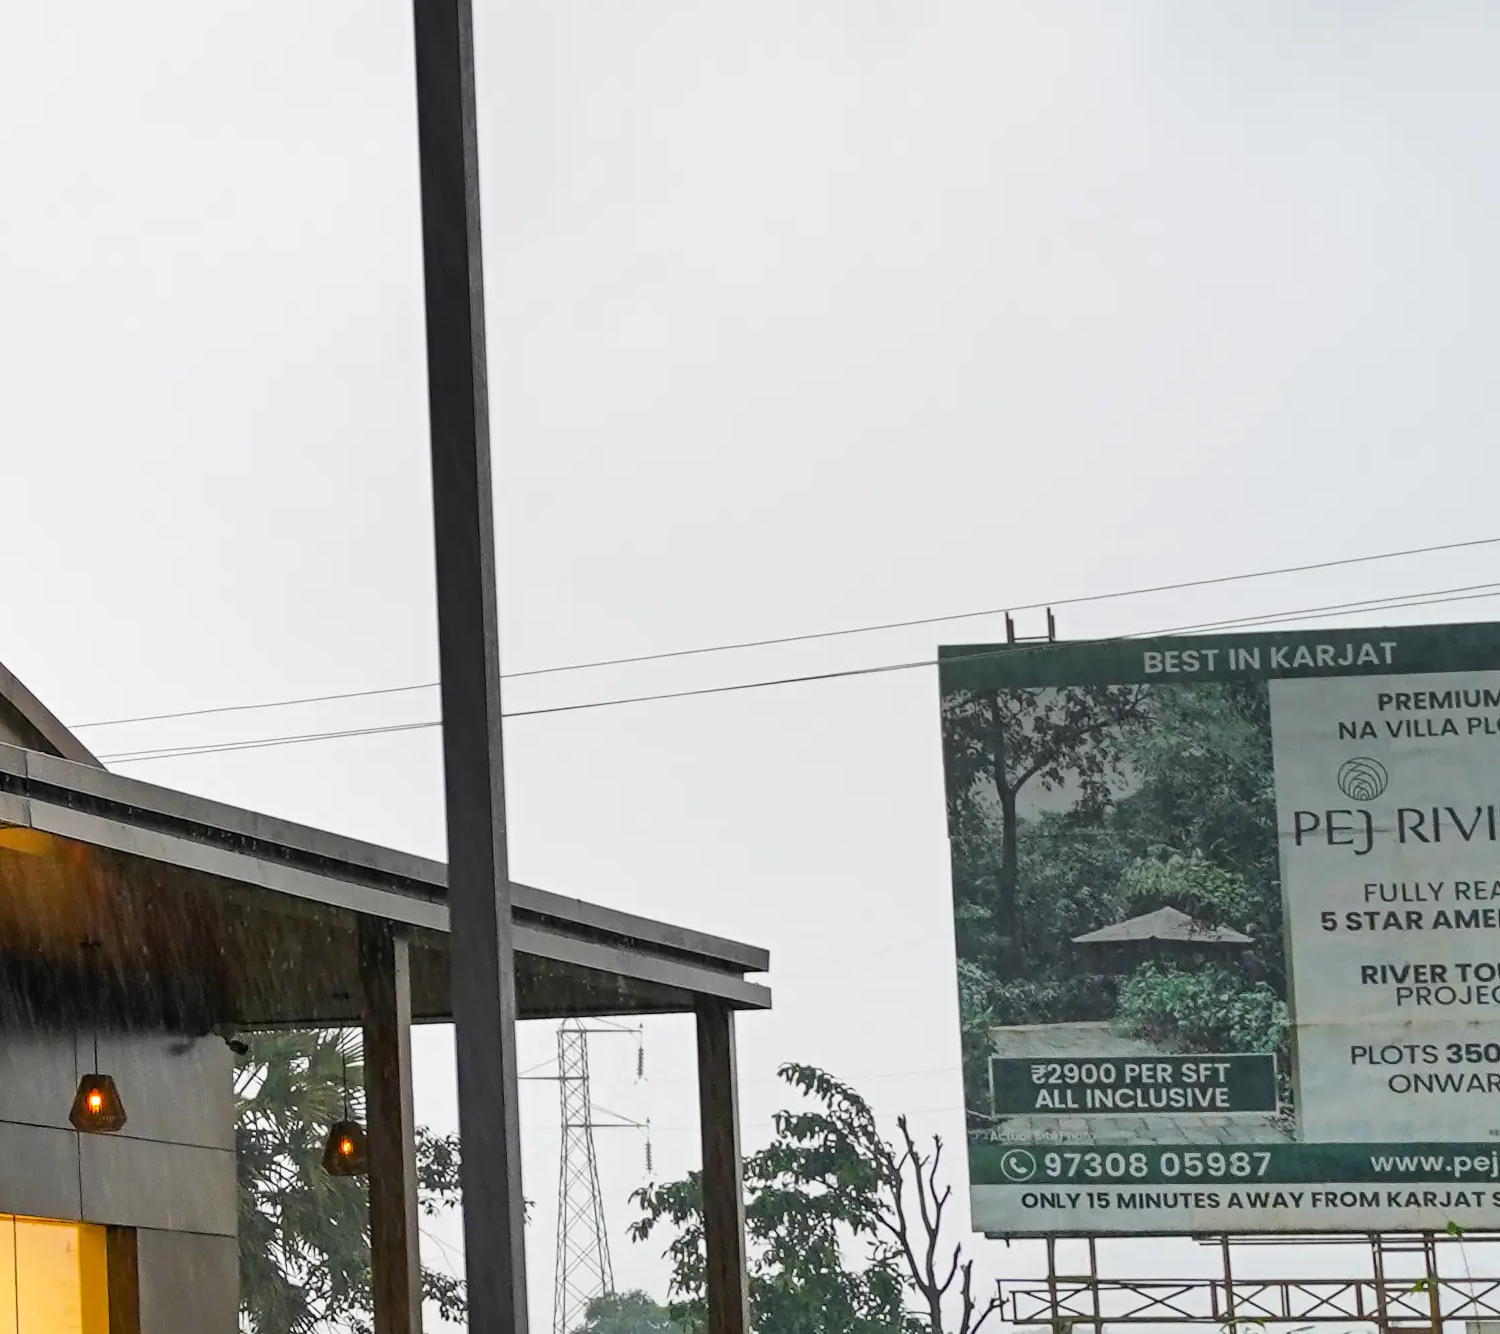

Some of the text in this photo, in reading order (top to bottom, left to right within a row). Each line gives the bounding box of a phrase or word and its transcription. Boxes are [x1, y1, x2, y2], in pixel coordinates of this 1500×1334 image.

[1143, 641, 1398, 675] BEST IN KARJAT
[1377, 688, 1500, 712] PREMIUM
[1338, 715, 1500, 741] NA VILLA PL
[1293, 808, 1376, 857] PEJ
[1363, 881, 1445, 903] FULLY
[1320, 908, 1500, 933] 5 STAR AME
[1360, 961, 1500, 986] RIVER TO
[1349, 1041, 1500, 1066] PLOTS 350
[1124, 1062, 1174, 1085] PER
[1181, 1061, 1232, 1084] SFT
[1387, 1072, 1500, 1095] ONWAR
[1034, 1087, 1231, 1110] ALL INCLUSIVE
[1044, 1150, 1273, 1179] 97308 05987
[1369, 1150, 1500, 1179] www.pej
[1020, 1192, 1082, 1211] ONLY
[1086, 1192, 1111, 1210] 15
[1116, 1191, 1221, 1210] MINUTES
[1311, 1191, 1381, 1209] FROM
[1386, 1190, 1487, 1209] KARJAT
